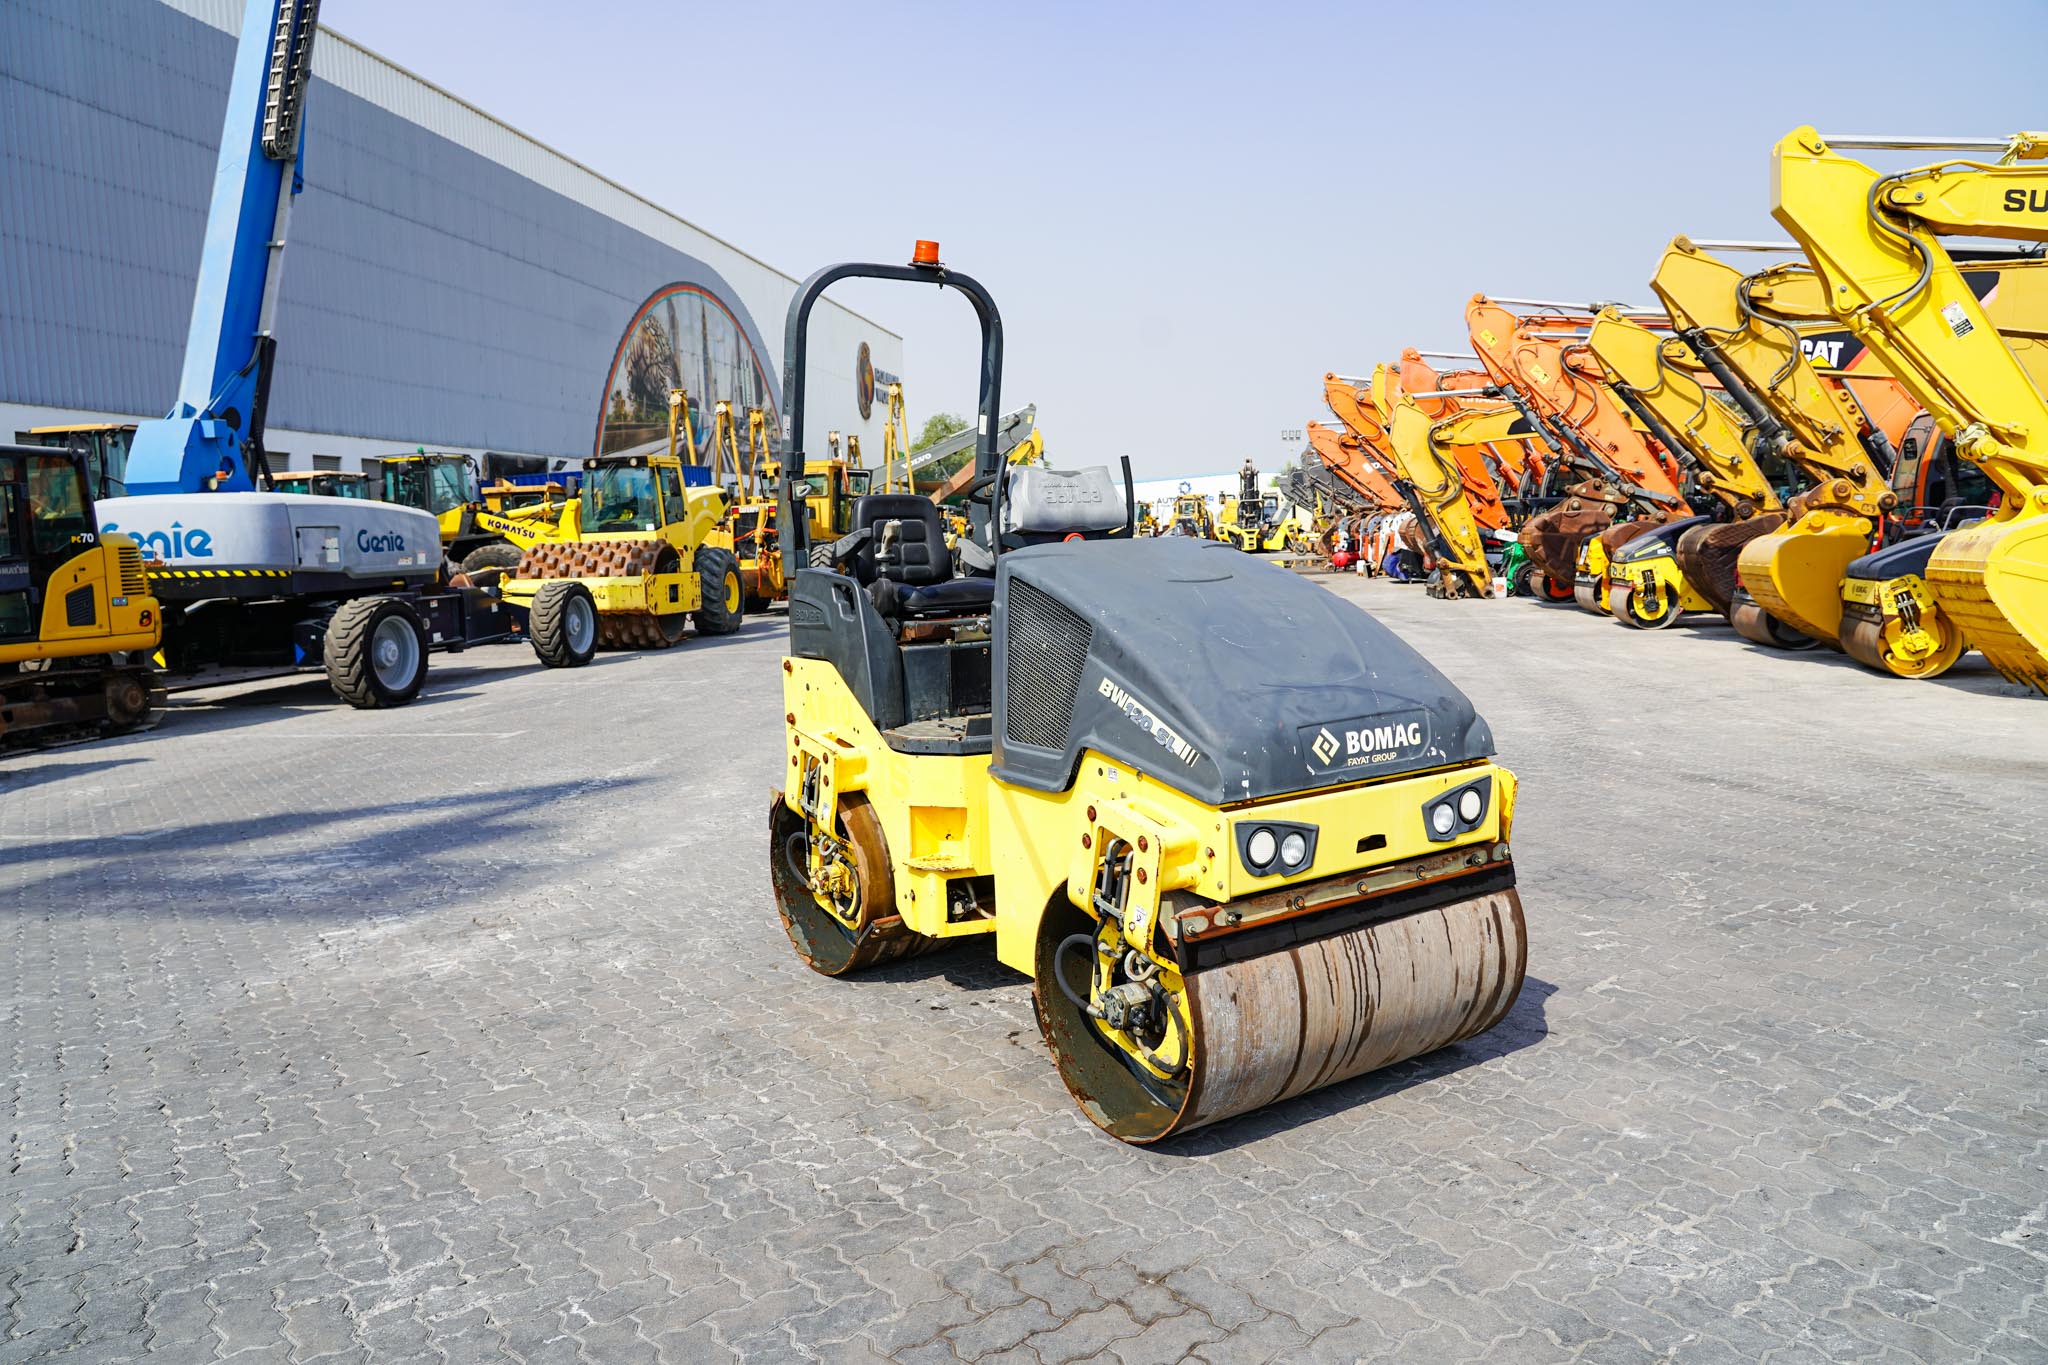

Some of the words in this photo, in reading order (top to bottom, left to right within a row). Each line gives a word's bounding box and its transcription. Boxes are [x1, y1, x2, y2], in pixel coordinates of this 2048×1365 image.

[1799, 339, 1844, 368] CAT
[71, 533, 94, 544] PC70
[487, 518, 536, 539] KOMATSU
[357, 529, 405, 552] Genie
[1345, 722, 1421, 755] BOMAG
[1347, 756, 1370, 767] FAYAT
[1371, 752, 1397, 763] GROUP
